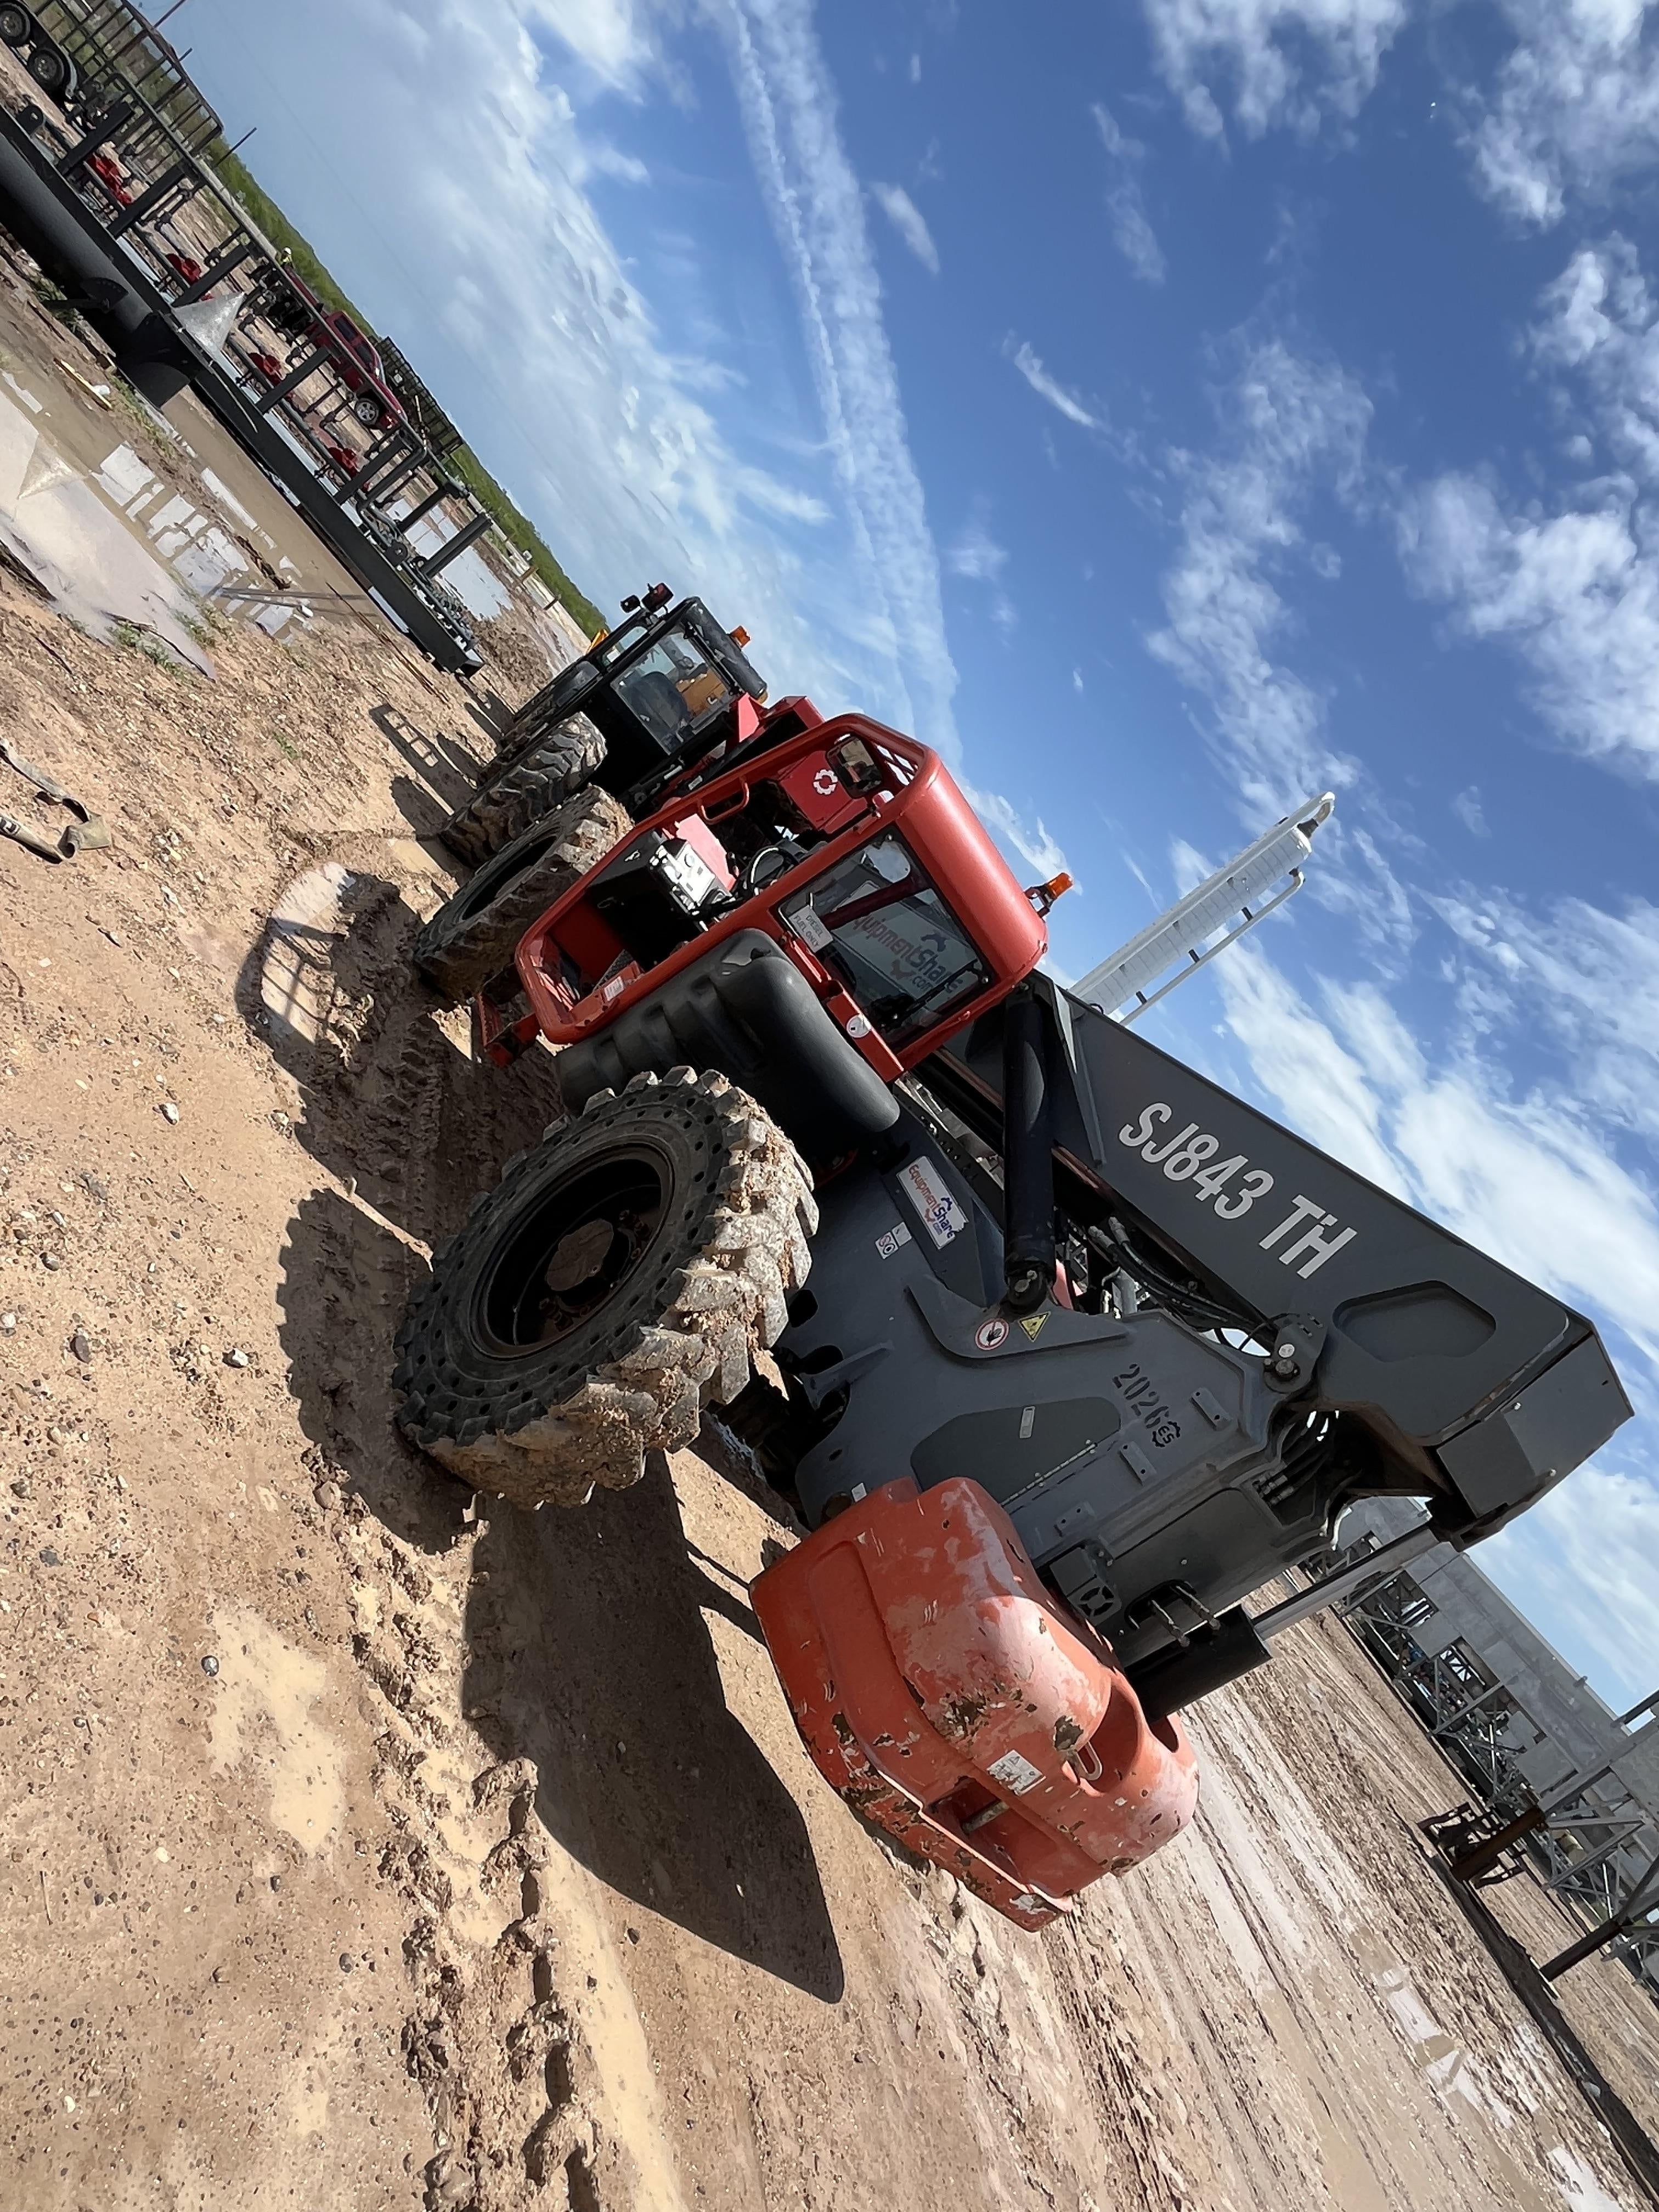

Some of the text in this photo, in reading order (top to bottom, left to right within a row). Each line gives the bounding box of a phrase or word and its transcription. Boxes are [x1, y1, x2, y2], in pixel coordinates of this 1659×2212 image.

[909, 1164, 954, 1239] EquipmentShare
[1119, 1103, 1357, 1279] SJ843 TH
[1112, 1364, 1170, 1428] 2026
